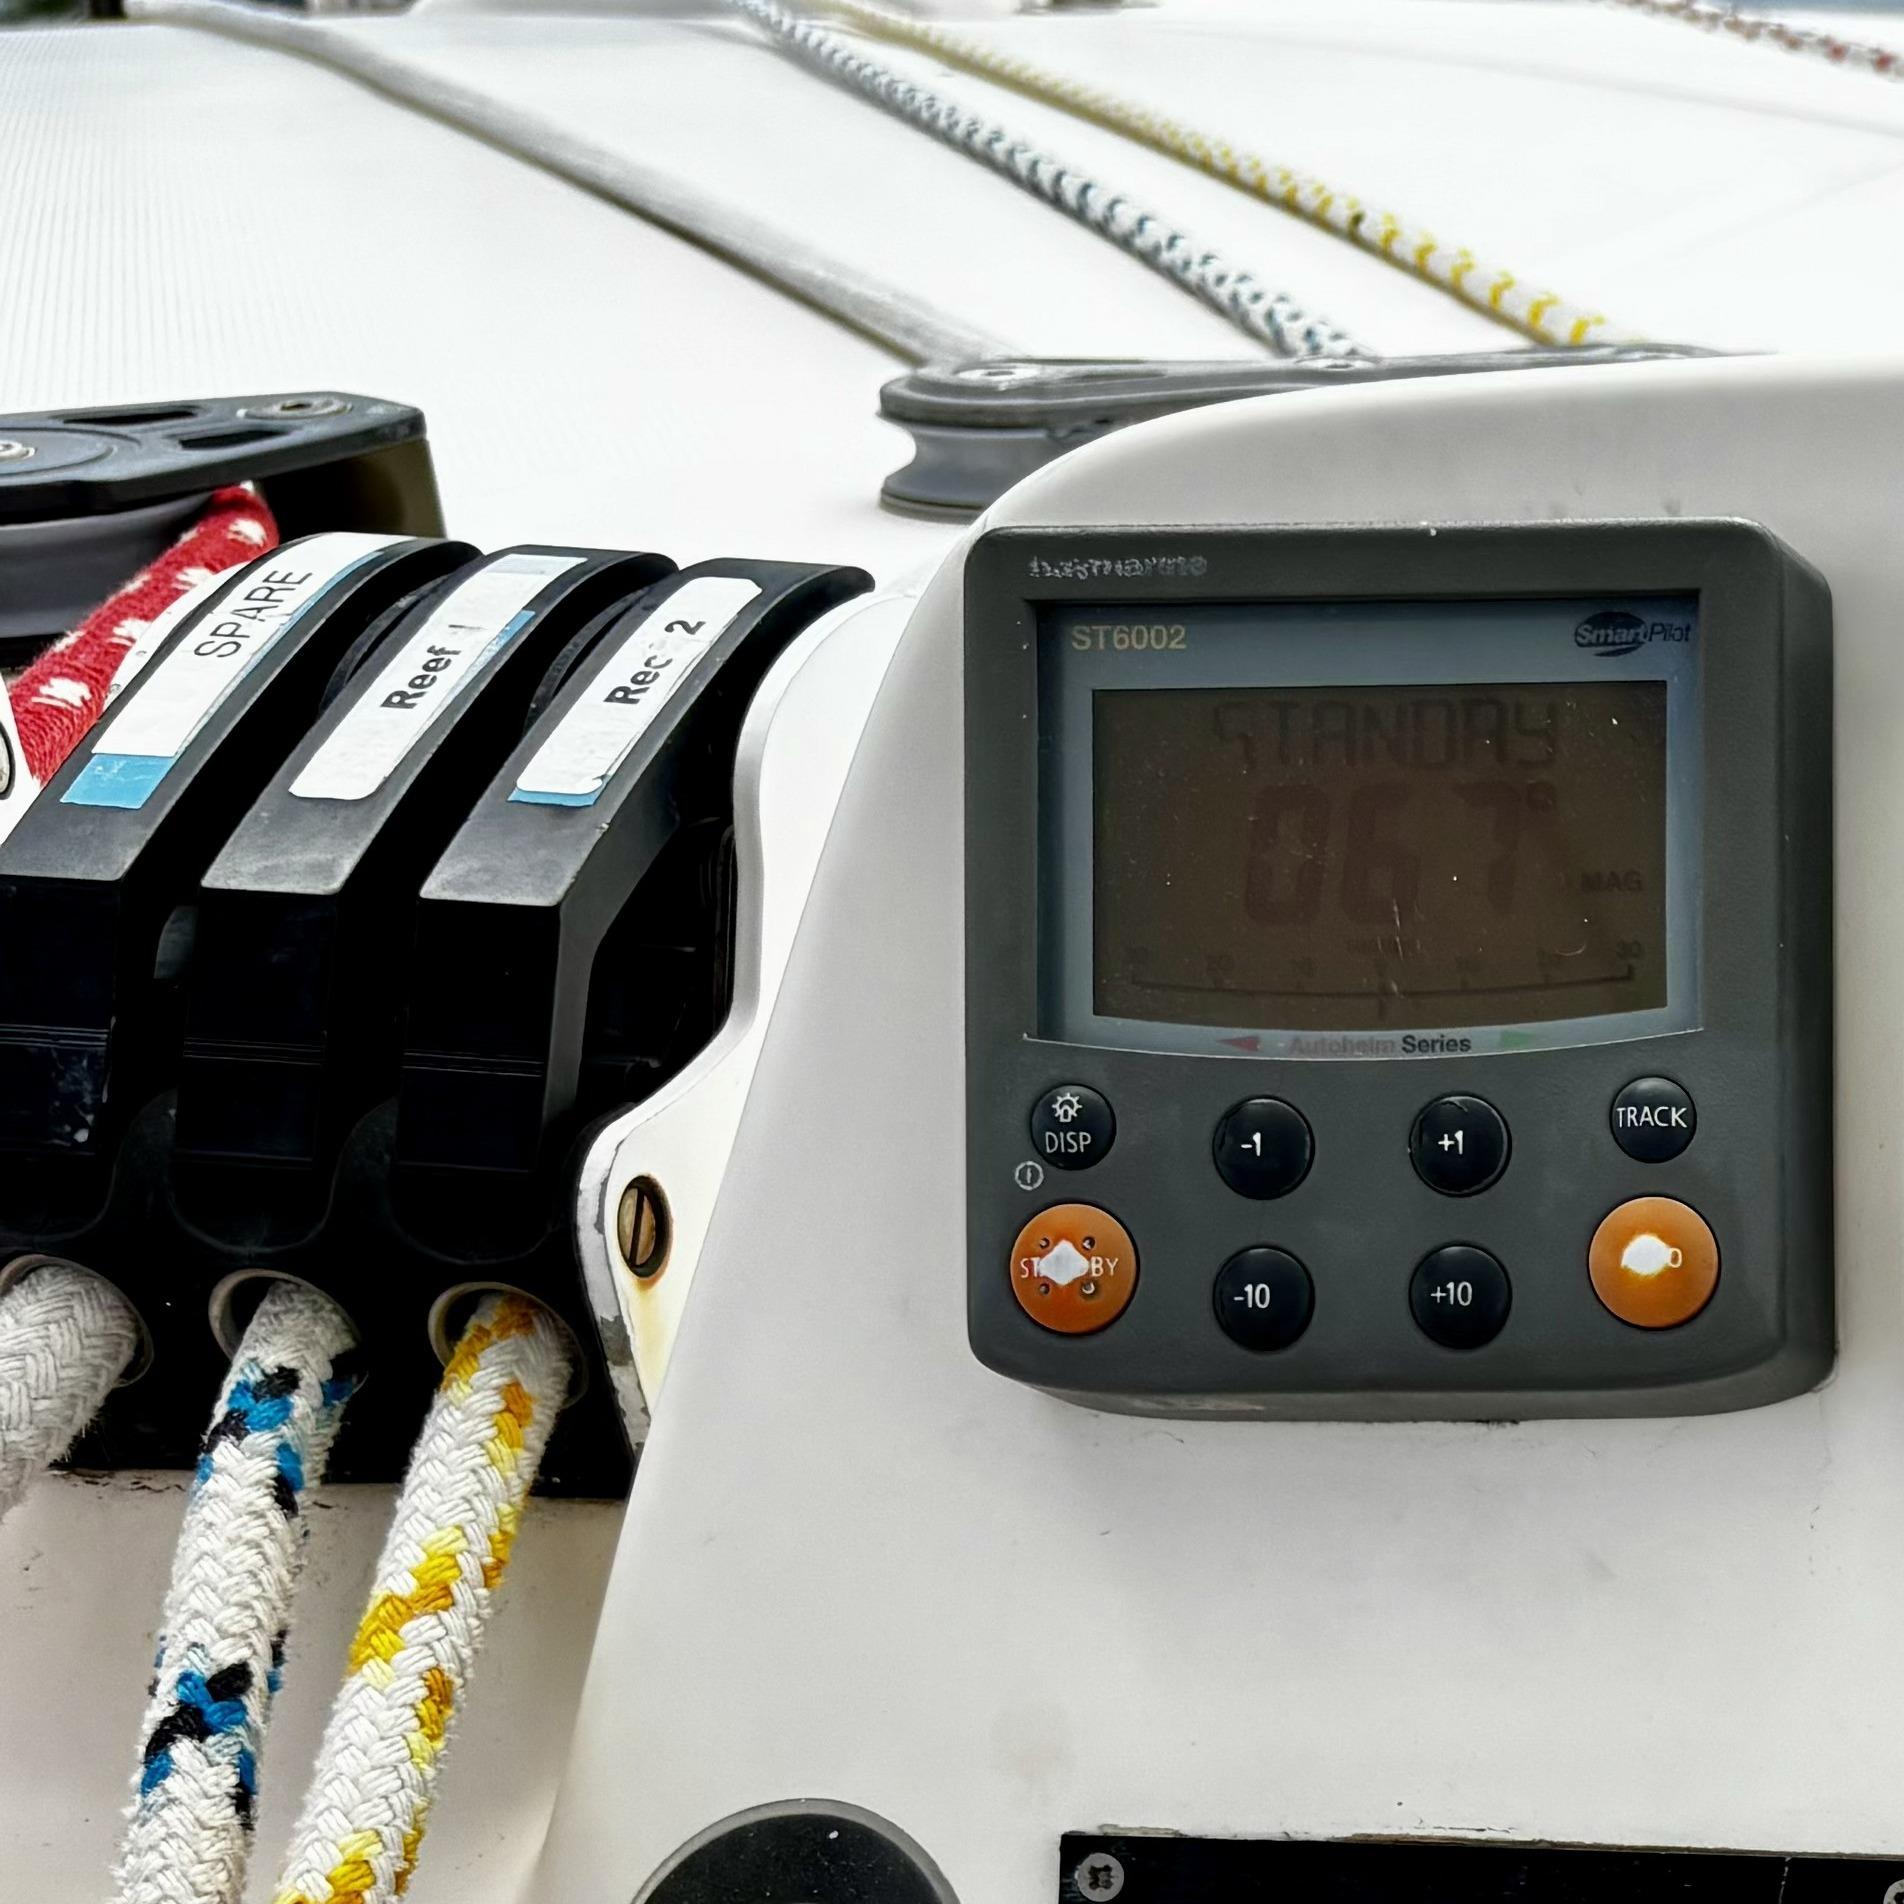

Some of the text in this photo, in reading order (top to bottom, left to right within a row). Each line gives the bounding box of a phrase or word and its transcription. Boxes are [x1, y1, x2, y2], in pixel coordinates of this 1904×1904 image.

[194, 570, 313, 658] SPARE
[664, 620, 706, 635] 2
[1071, 624, 1187, 652] ST6002
[380, 645, 462, 710] Reef
[1578, 870, 1644, 893] MAG
[1401, 1033, 1472, 1056] Series
[1616, 1104, 1688, 1130] TRACK
[1044, 1131, 1092, 1154] DISP
[1240, 1131, 1263, 1157] -1
[1437, 1130, 1466, 1156] +1
[1020, 1256, 1120, 1279] STBY
[1232, 1284, 1271, 1310] -10
[1430, 1281, 1473, 1308] +10
